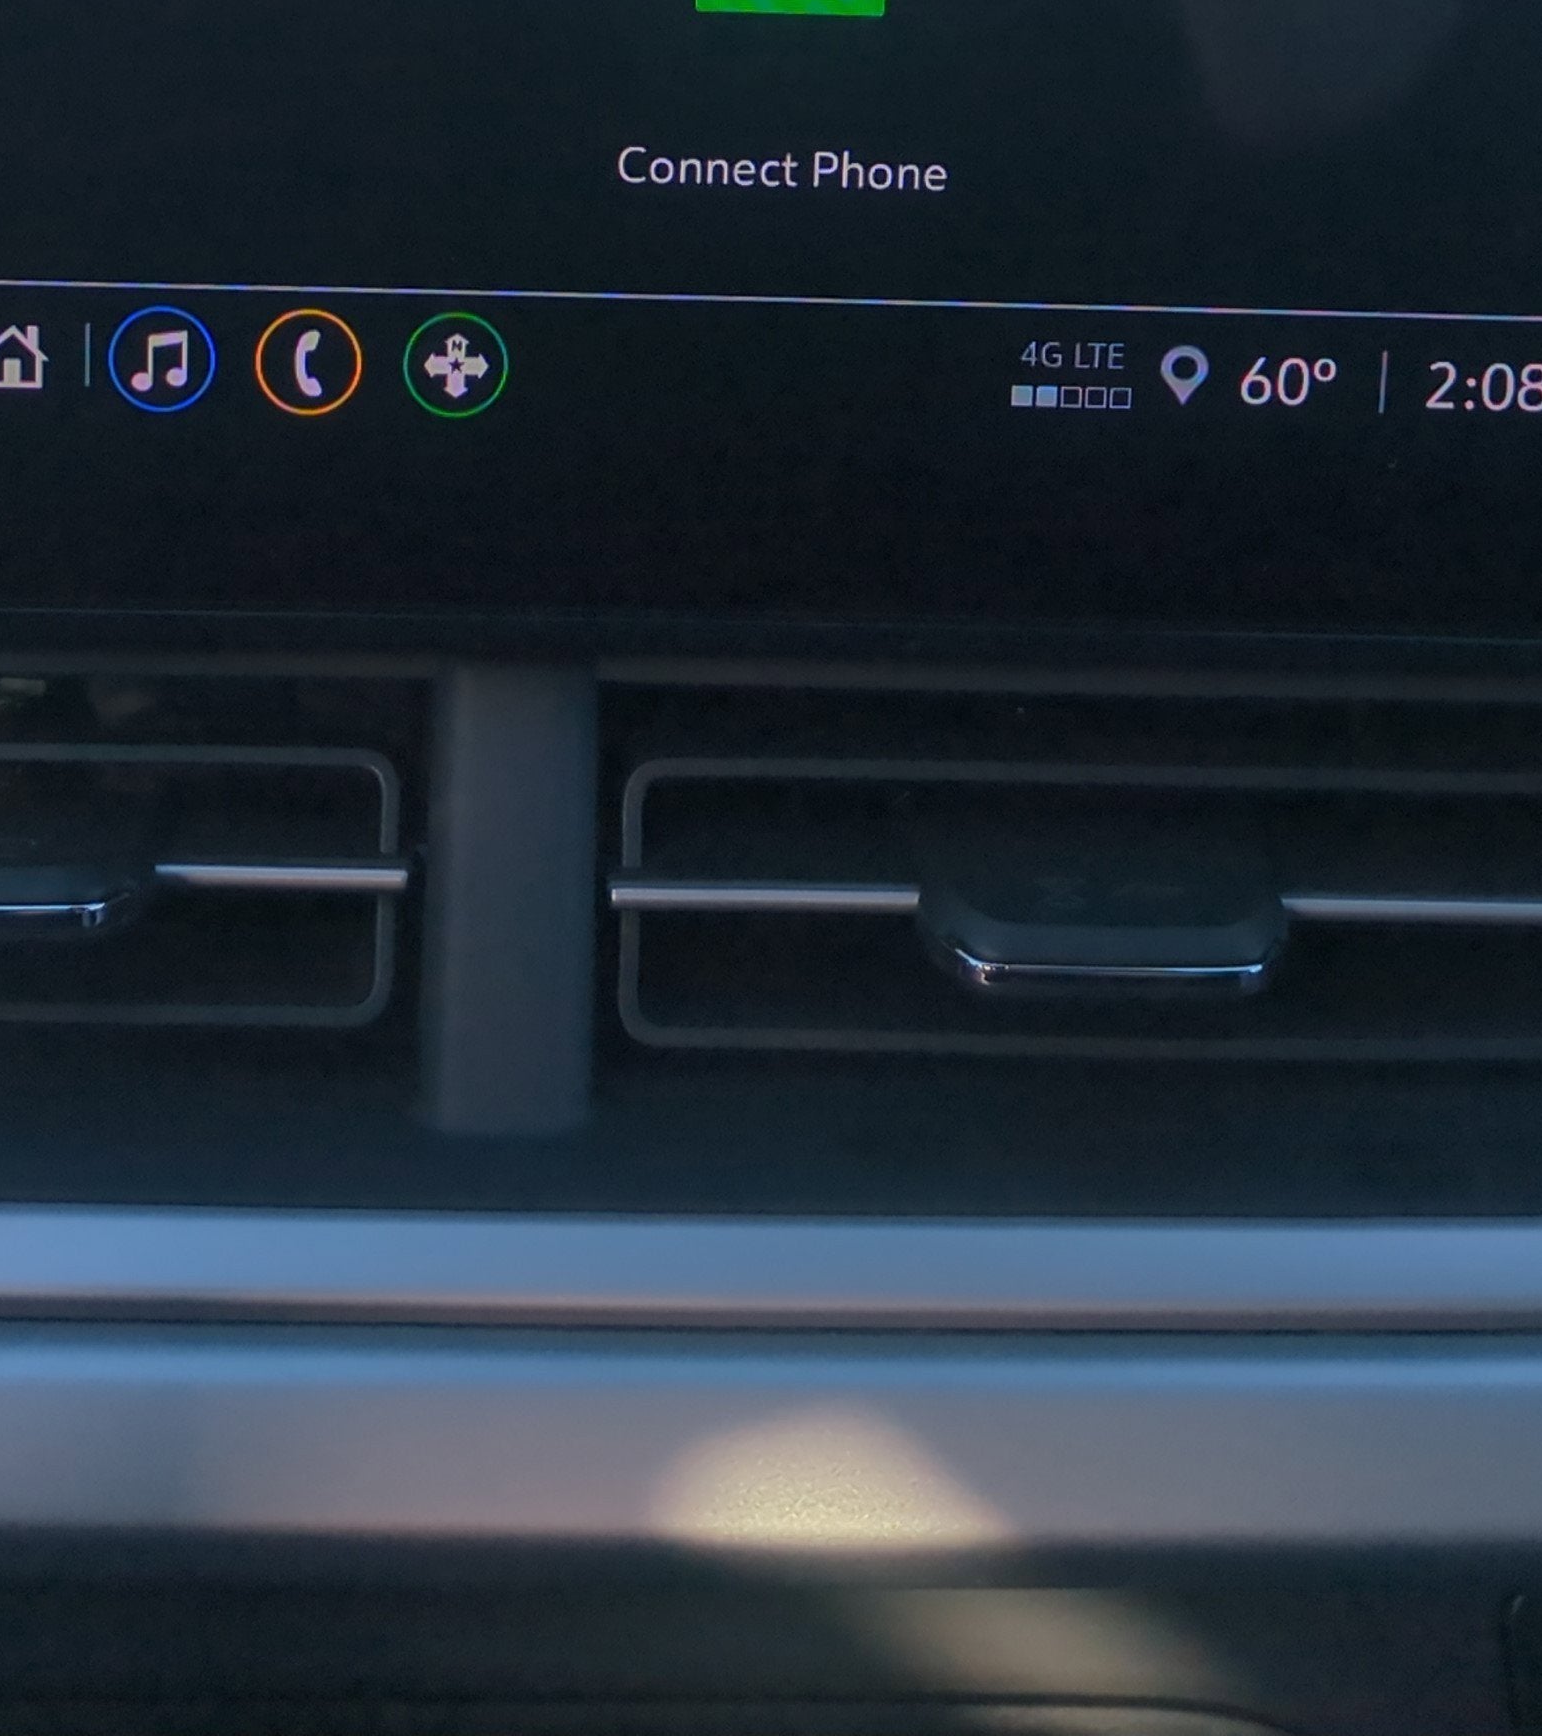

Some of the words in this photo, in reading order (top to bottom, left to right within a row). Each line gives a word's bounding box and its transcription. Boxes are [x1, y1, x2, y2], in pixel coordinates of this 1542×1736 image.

[616, 145, 799, 188] Connect
[812, 149, 949, 192] Phone
[1020, 340, 1063, 368] 4G
[1073, 342, 1126, 371] LTE
